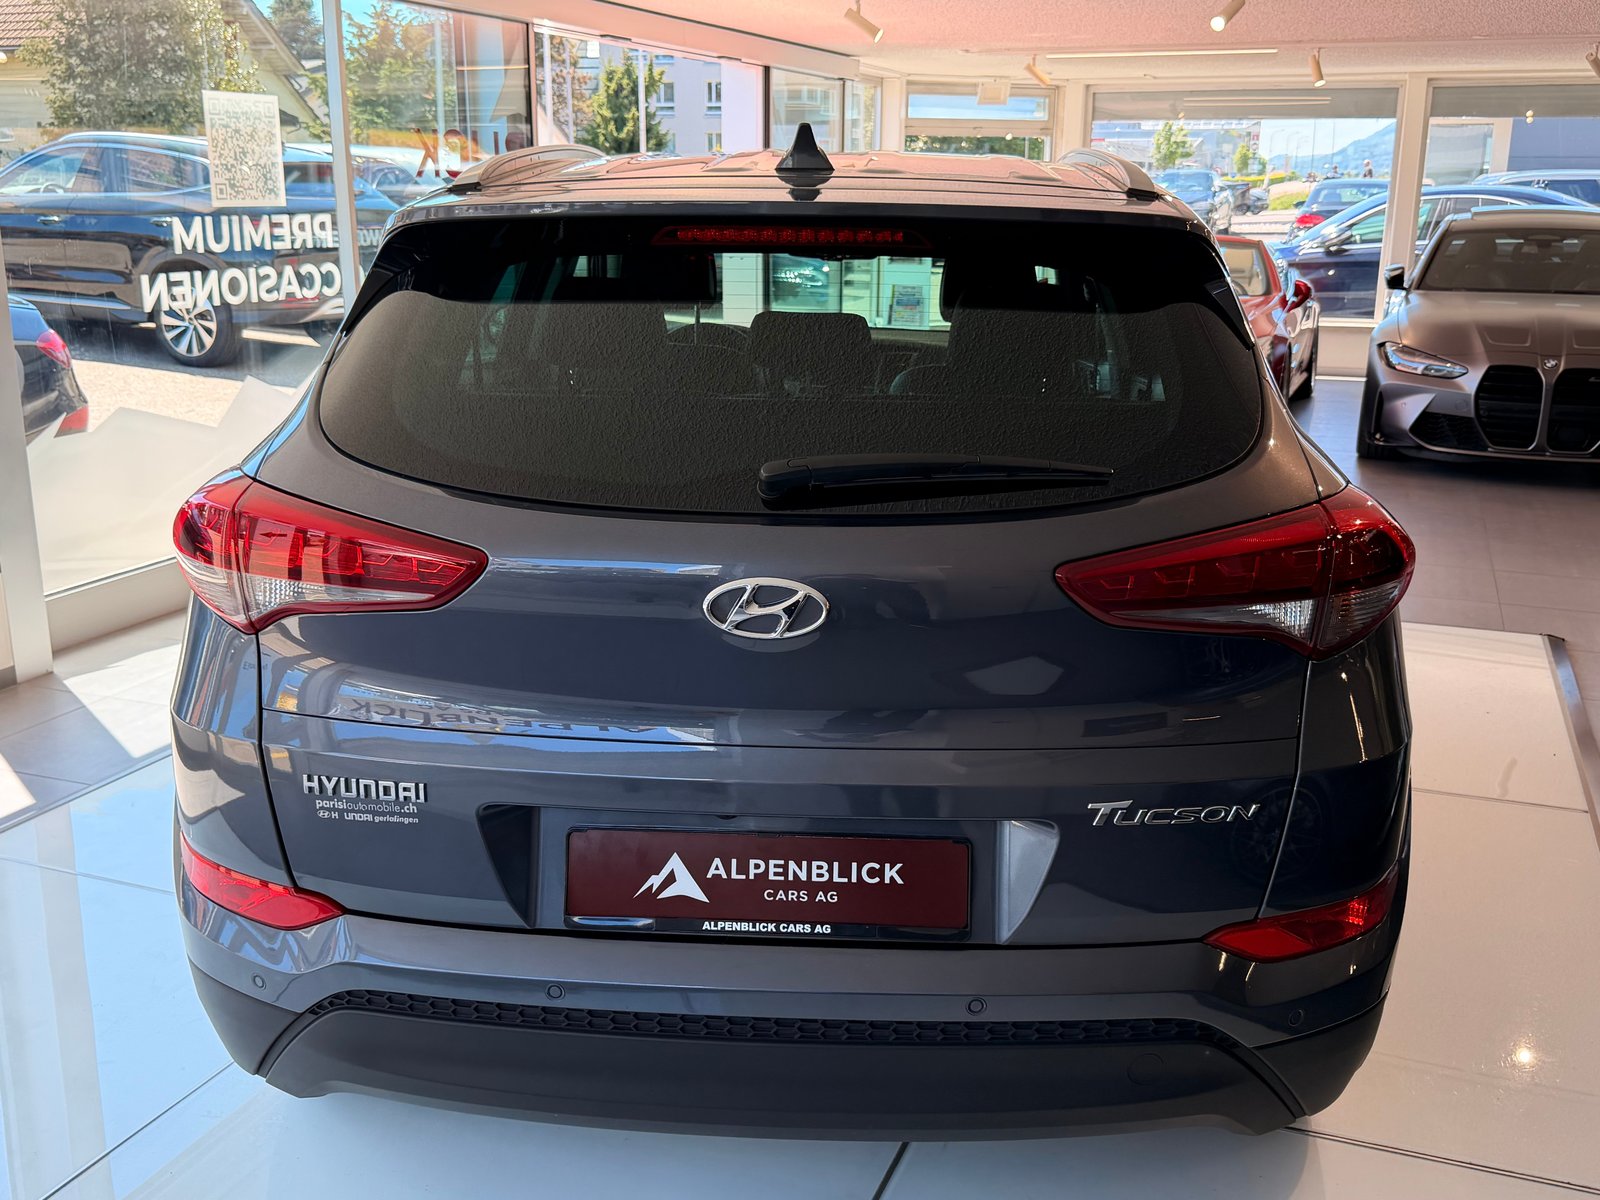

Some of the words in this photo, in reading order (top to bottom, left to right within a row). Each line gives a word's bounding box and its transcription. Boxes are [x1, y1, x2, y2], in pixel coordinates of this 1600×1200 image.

[302, 774, 427, 803] HYUNDAI
[315, 798, 418, 813] parisiautomobile.ch
[706, 857, 905, 885] ALPENBLICK
[763, 889, 809, 902] CARS
[815, 891, 838, 903] AG
[702, 921, 776, 933] ALPENBLICK
[779, 923, 812, 934] CARS
[814, 924, 832, 935] AG
